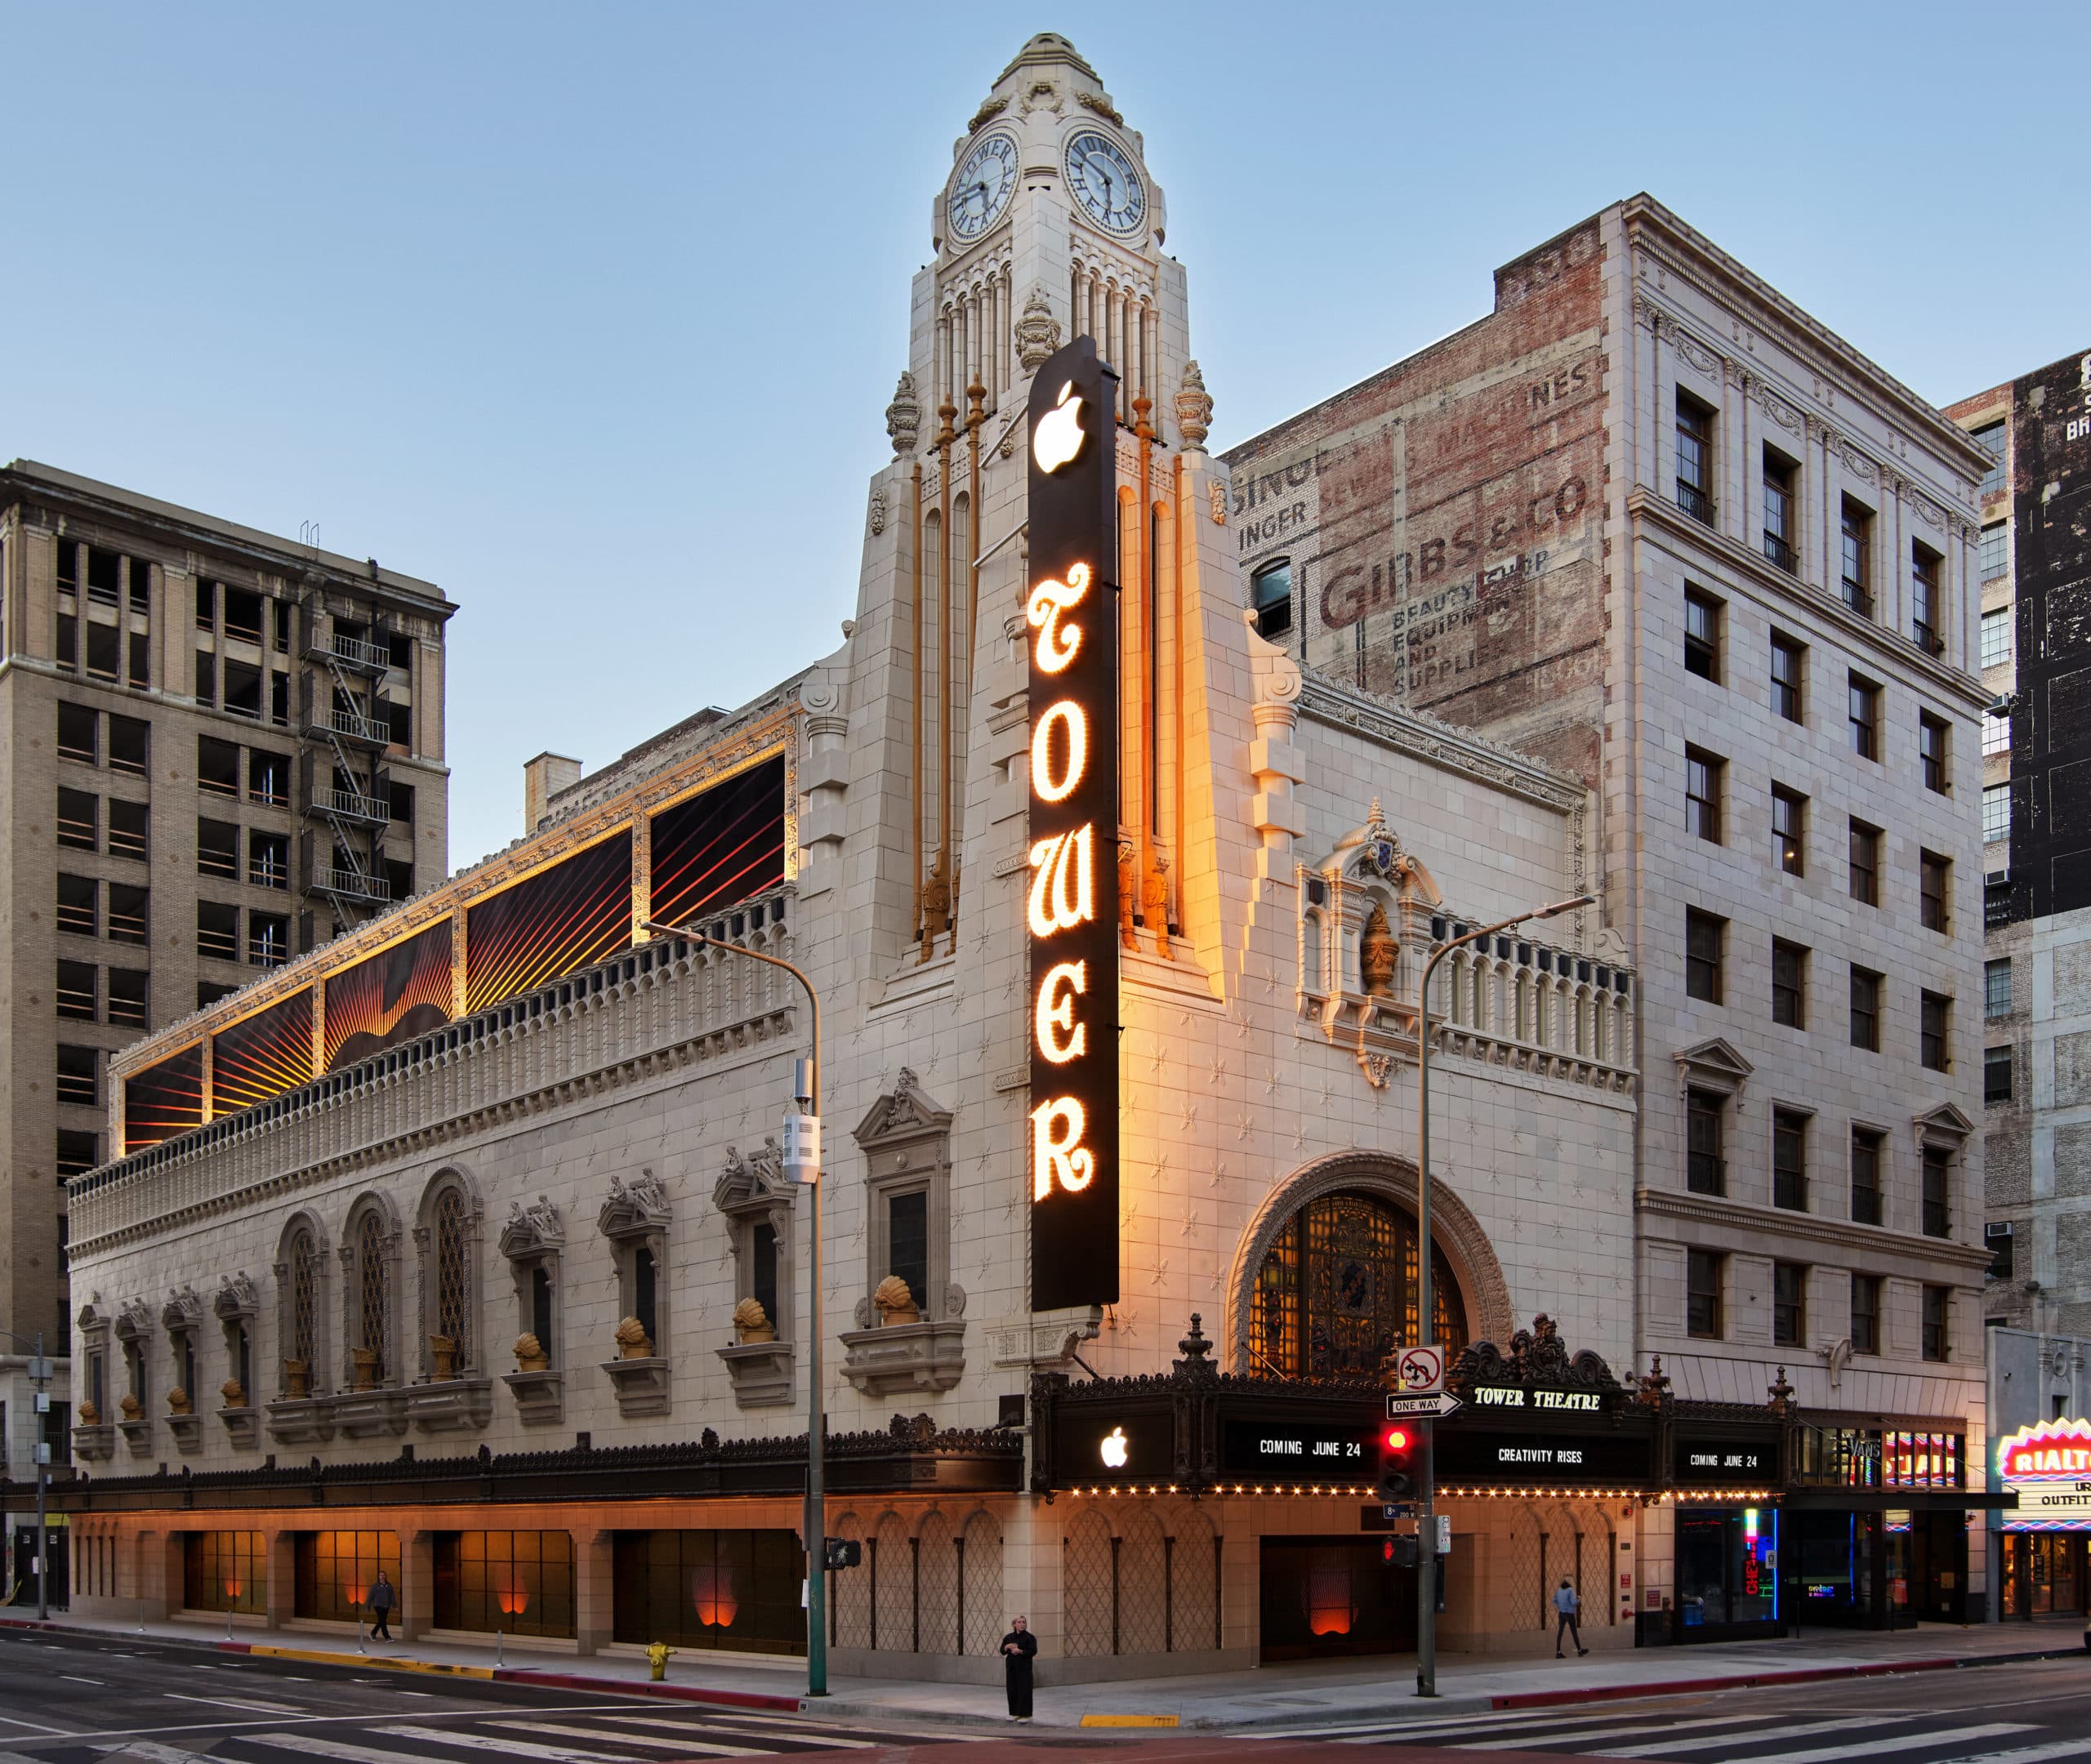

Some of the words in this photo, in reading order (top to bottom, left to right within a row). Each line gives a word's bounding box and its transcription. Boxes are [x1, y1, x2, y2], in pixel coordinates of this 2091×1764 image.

[1320, 523, 1478, 630] GIBBS
[1027, 562, 1095, 1204] TOWER
[1396, 1402, 1416, 1410] ONE
[1419, 1400, 1439, 1410] WAY
[1474, 1388, 1525, 1406] TOWER
[1534, 1391, 1601, 1411] THEATRE
[1260, 1440, 1302, 1454] COMING
[1313, 1441, 1340, 1456] JUNE
[1347, 1443, 1361, 1457] 24
[1498, 1449, 1553, 1463] CREATIVITY
[1557, 1450, 1583, 1463] RISES
[1848, 1437, 1881, 1458] VANS
[1690, 1454, 1718, 1466] COMING
[1723, 1455, 1743, 1467] JUNE
[1746, 1455, 1757, 1468] 24
[2015, 1448, 2091, 1472] RIALT
